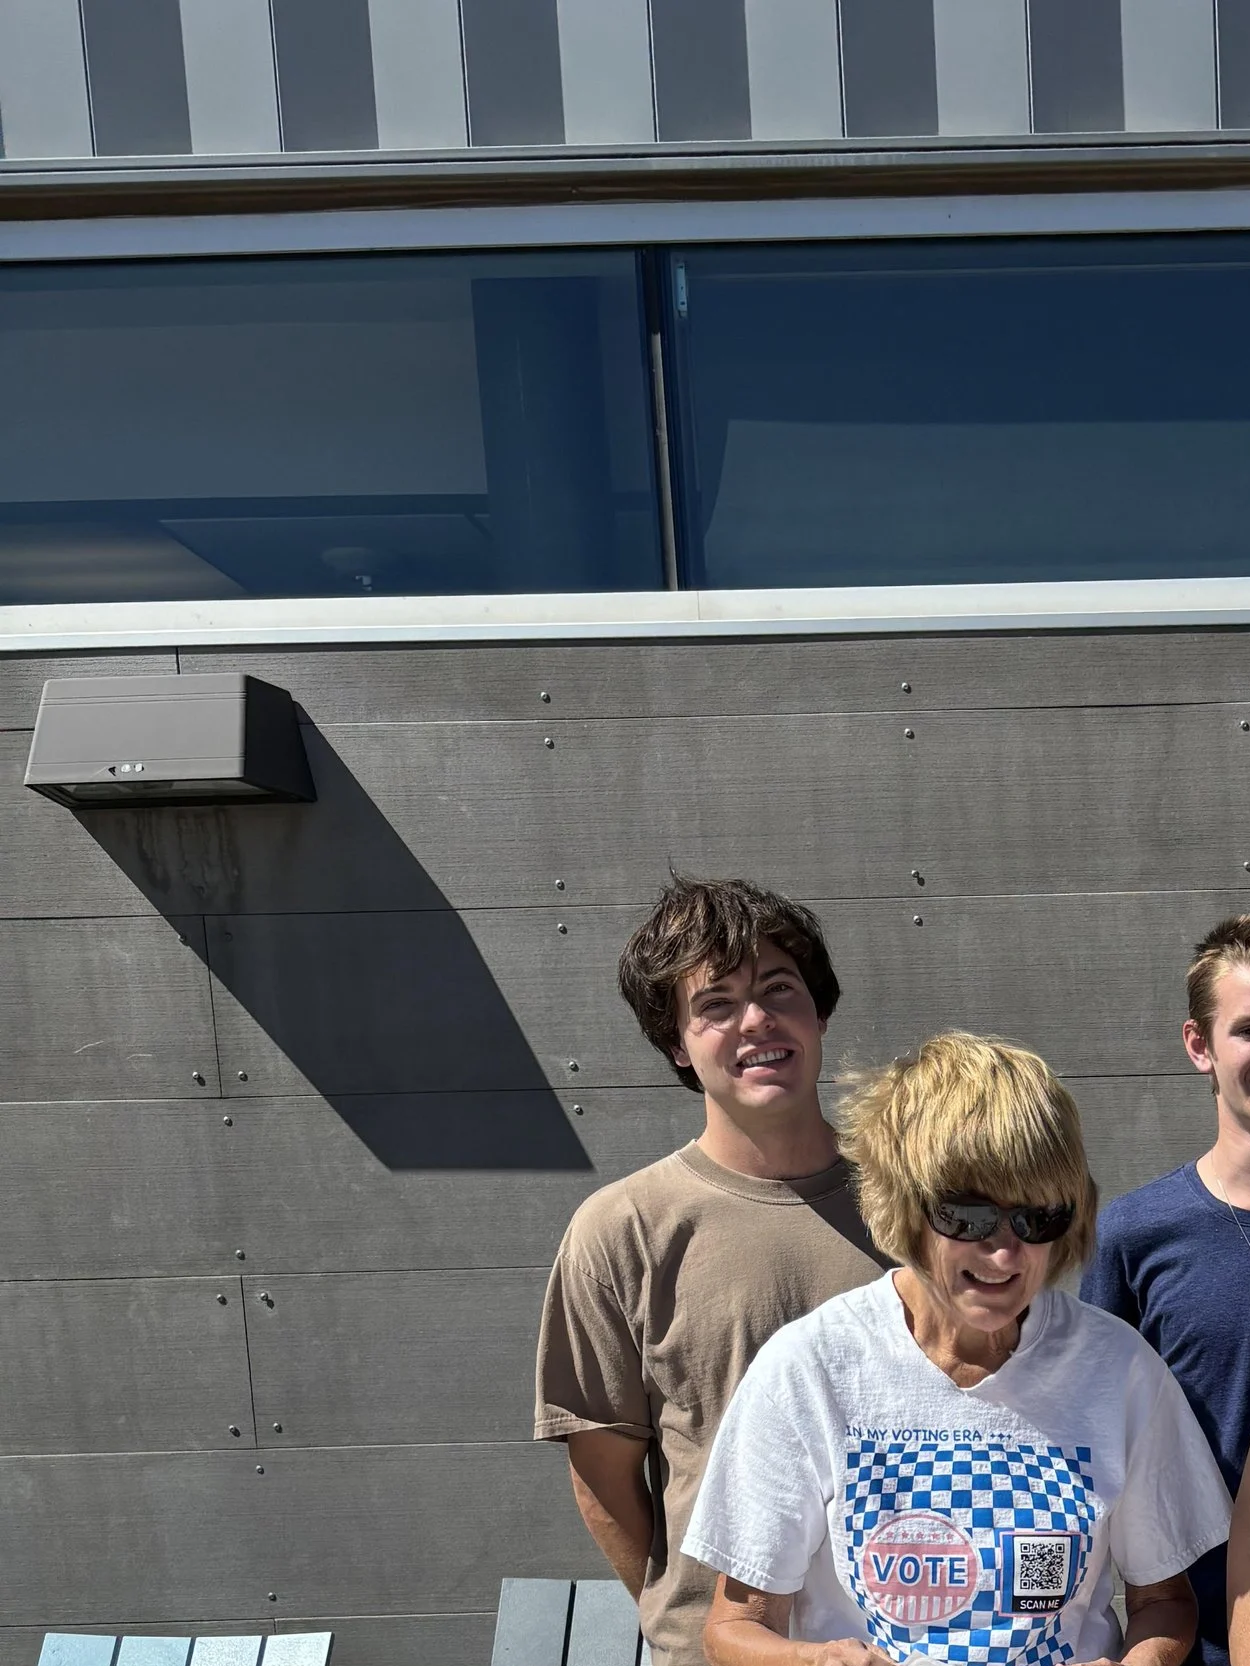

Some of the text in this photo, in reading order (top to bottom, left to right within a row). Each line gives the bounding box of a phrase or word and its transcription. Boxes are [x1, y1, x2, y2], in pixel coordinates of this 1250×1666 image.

[846, 1425, 982, 1442] IN MY VOTING ERA
[870, 1553, 967, 1586] VOTE
[1020, 1599, 1060, 1610] SCAN ME
